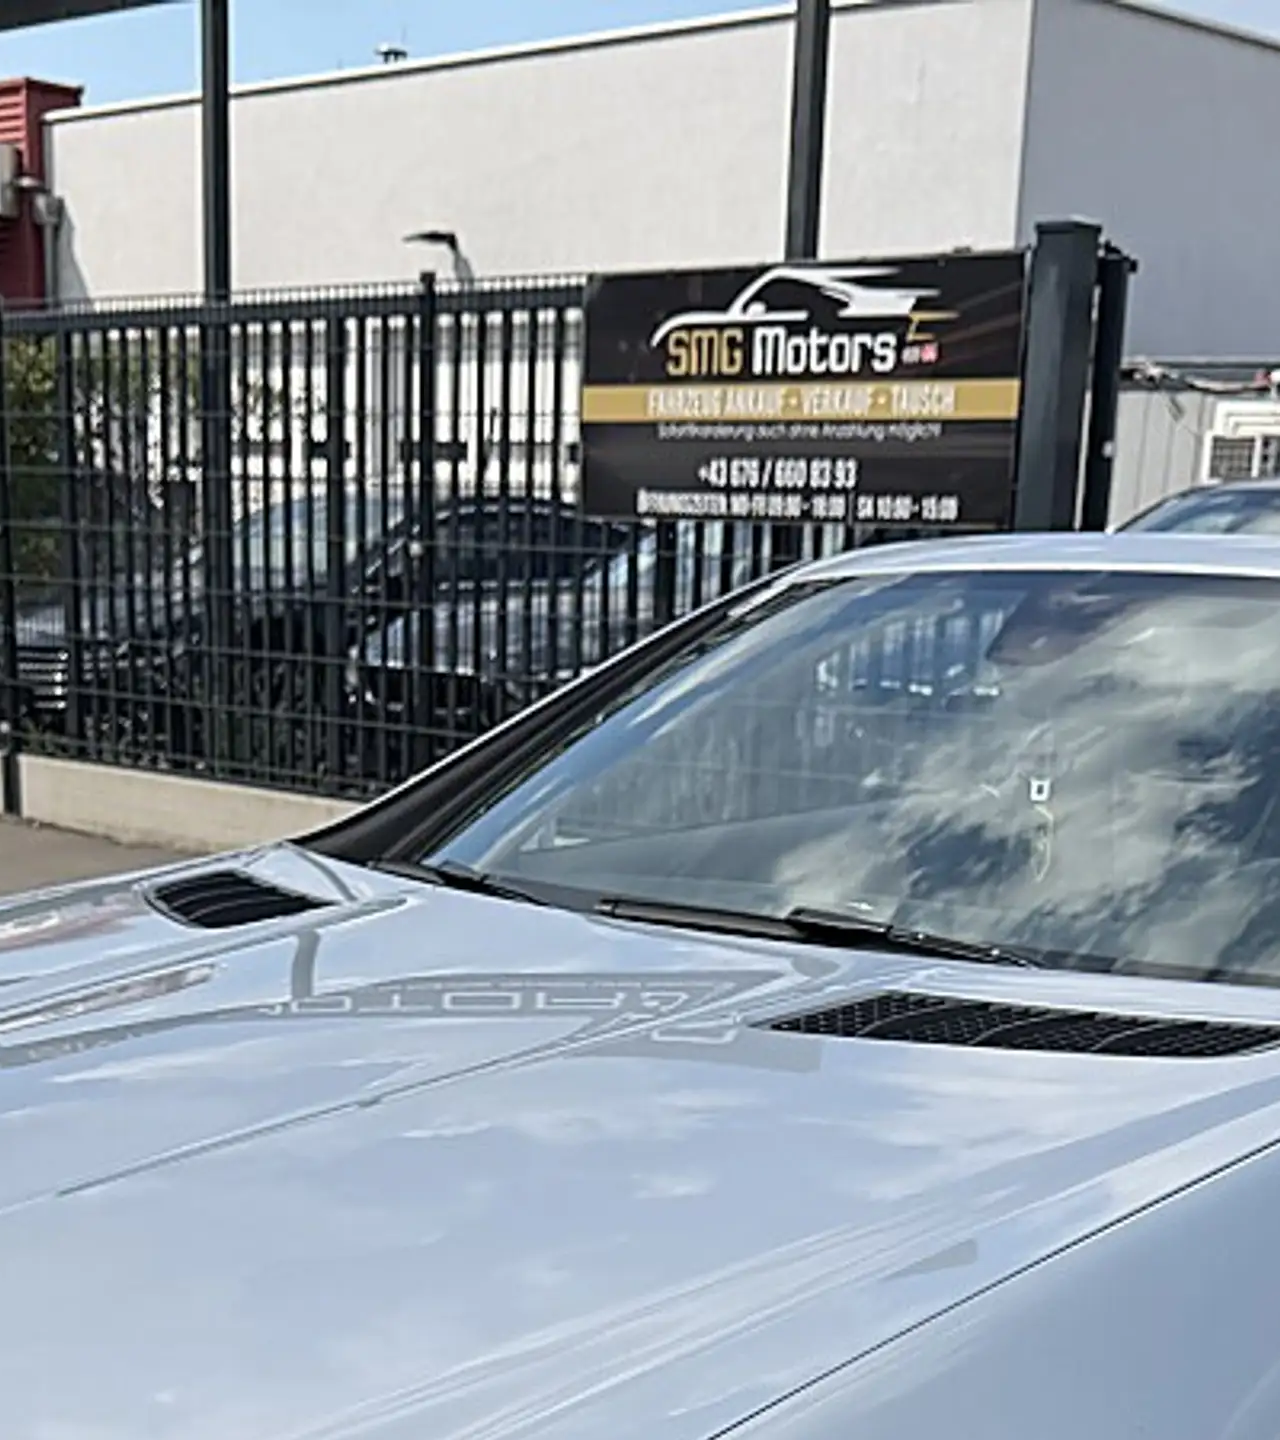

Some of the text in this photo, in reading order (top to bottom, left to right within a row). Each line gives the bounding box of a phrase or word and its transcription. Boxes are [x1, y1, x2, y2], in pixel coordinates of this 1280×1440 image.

[667, 329, 744, 376] SMG
[752, 326, 897, 376] Motors
[801, 384, 871, 415] VERKAUF
[893, 382, 955, 414] TAUSCH
